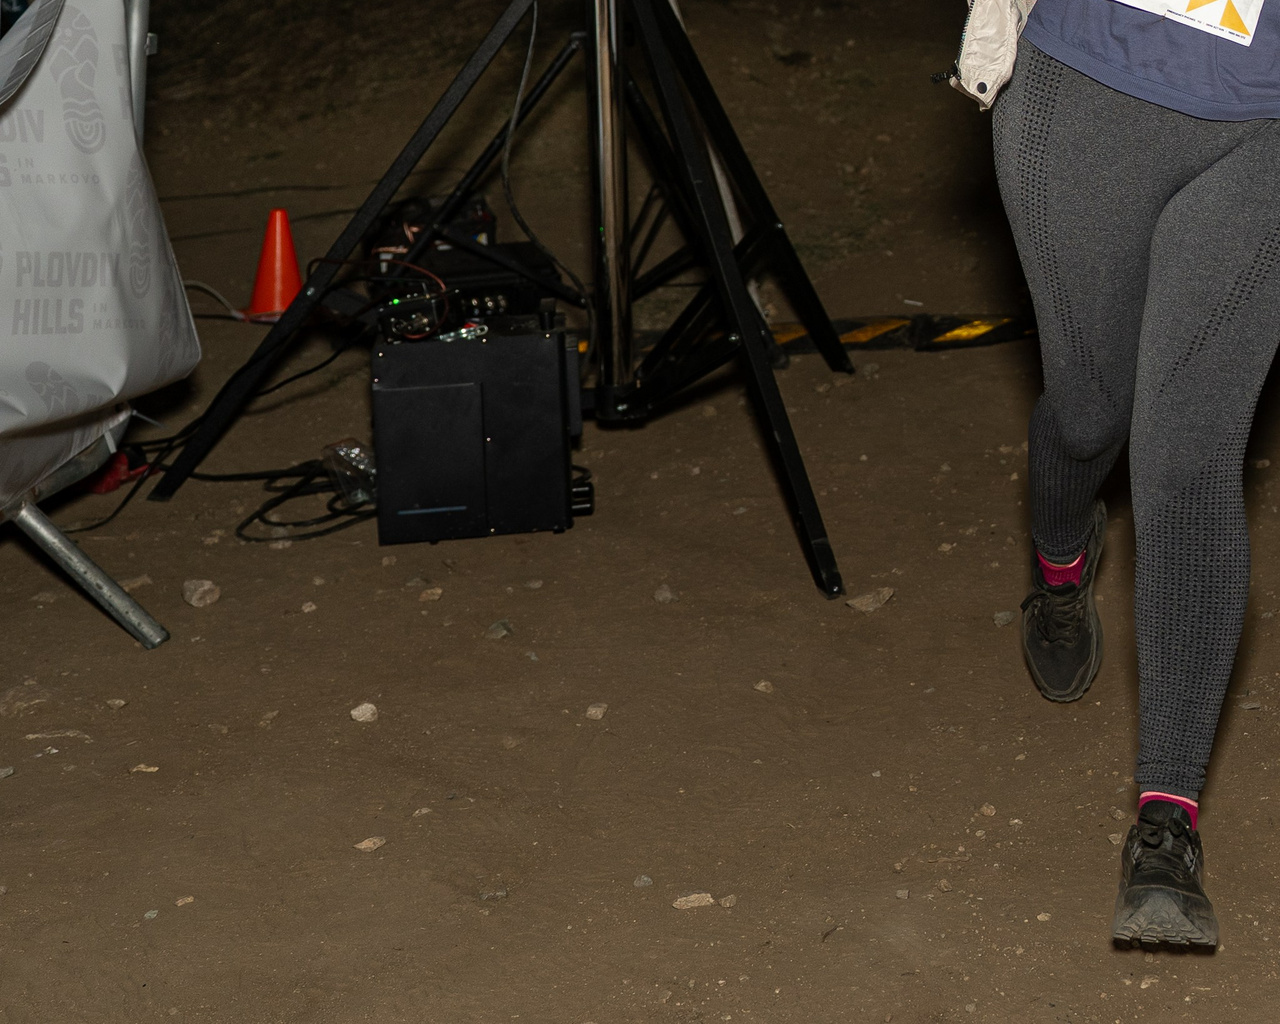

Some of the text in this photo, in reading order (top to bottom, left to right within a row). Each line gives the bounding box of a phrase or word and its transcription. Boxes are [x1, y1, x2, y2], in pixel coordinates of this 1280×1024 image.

[20, 173, 100, 184] MARKOVO
[16, 251, 121, 288] PLOVDIV
[12, 299, 84, 336] HILLS
